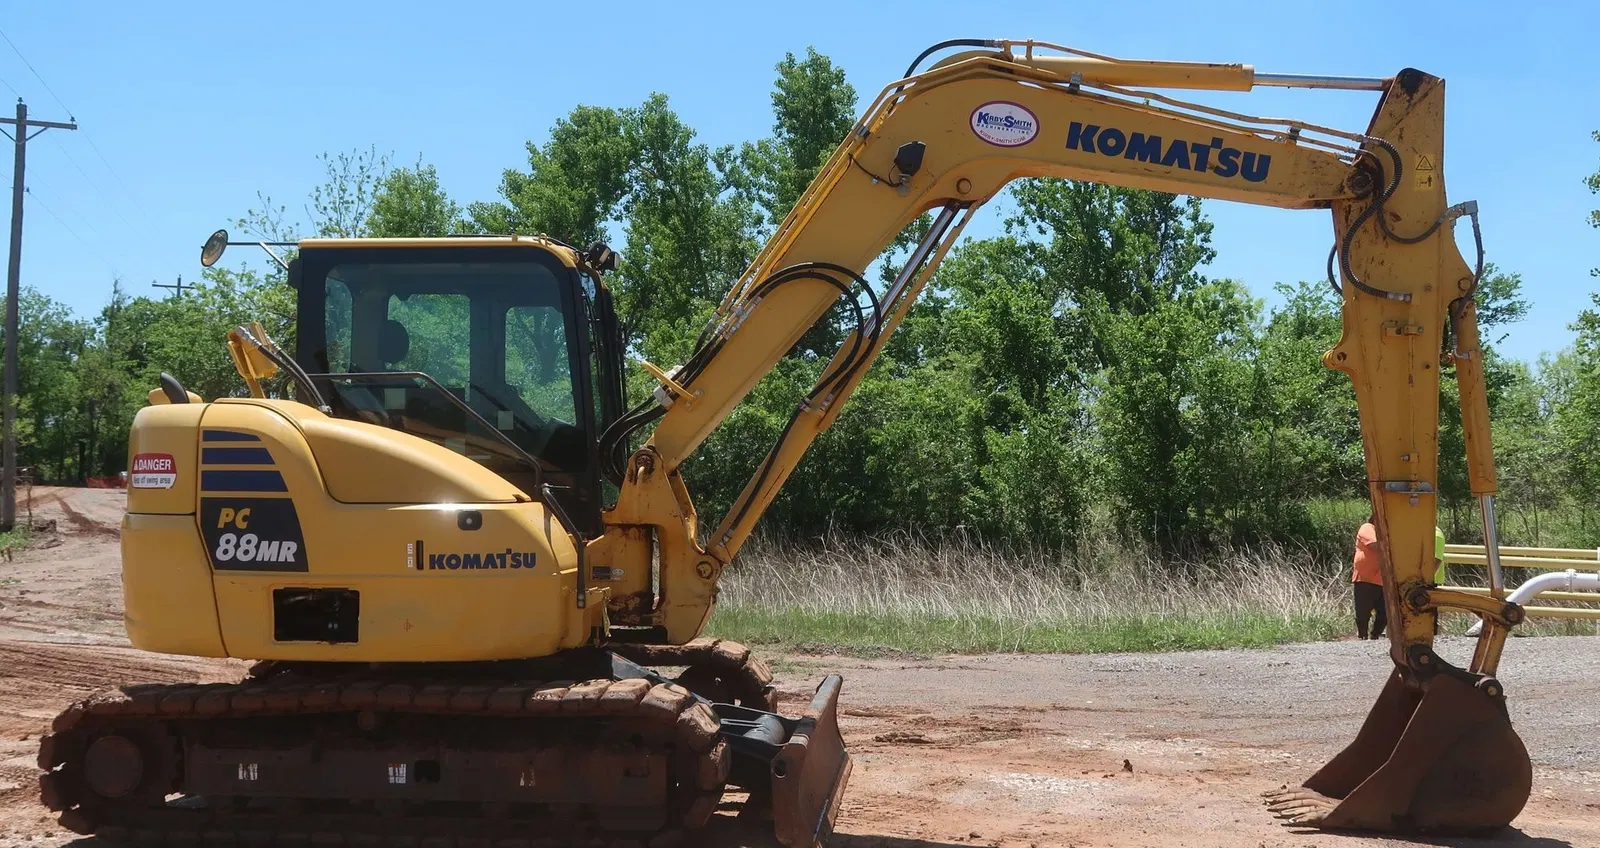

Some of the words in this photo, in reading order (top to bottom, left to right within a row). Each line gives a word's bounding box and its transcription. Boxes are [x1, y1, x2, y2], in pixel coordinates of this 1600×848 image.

[1065, 121, 1271, 182] KOMATSU
[139, 459, 171, 470] DANGER
[217, 507, 251, 529] PC
[215, 533, 298, 562] 88MR
[429, 548, 536, 570] KOMATSU
